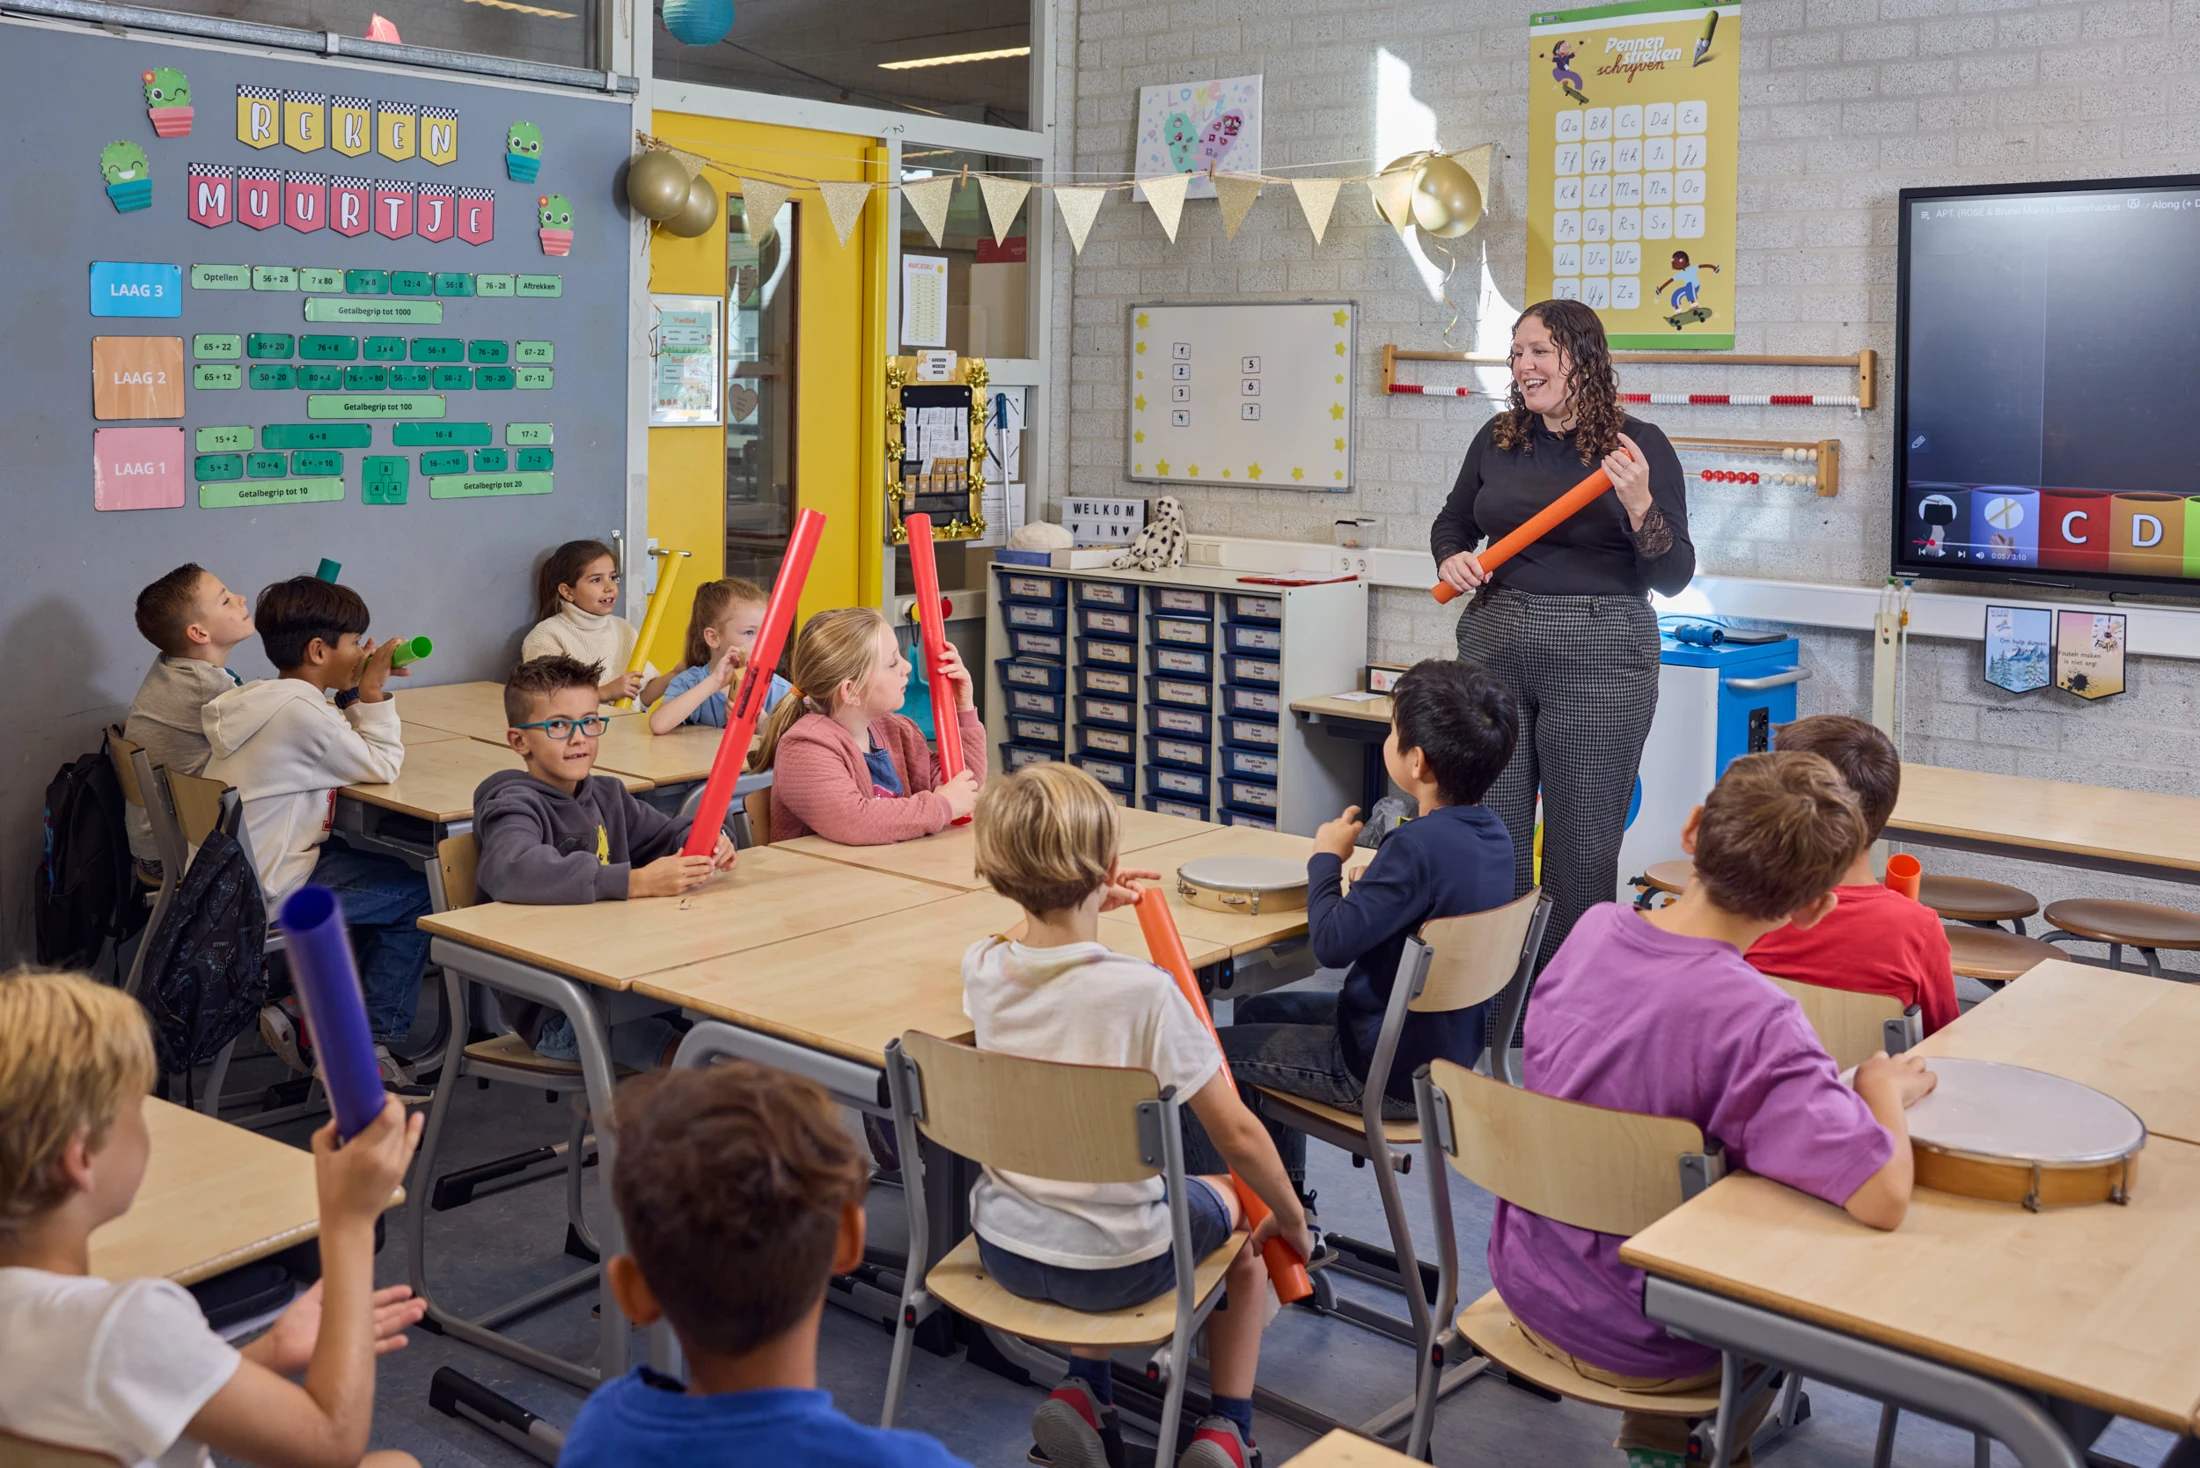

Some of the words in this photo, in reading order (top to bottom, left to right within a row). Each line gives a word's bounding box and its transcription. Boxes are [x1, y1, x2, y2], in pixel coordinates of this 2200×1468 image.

[1605, 37, 1665, 53] Pennen
[1623, 48, 1682, 64] streken
[251, 102, 452, 157] REKEN
[198, 182, 480, 234] MUURTJE
[2152, 200, 2180, 211] Along
[204, 273, 238, 281] Optellen
[111, 284, 150, 298] LAAG
[155, 285, 163, 298] 3
[523, 282, 555, 290] Aftrekken
[338, 307, 381, 316] Getalbegrip
[395, 308, 411, 316] 1000
[1179, 347, 1184, 355] 1
[1249, 360, 1254, 369] 5
[1179, 368, 1184, 376] 2
[114, 372, 153, 385] LAAG
[157, 372, 166, 384] 2
[1179, 389, 1184, 397] 3
[344, 403, 386, 412] Getalbegrip
[1178, 414, 1184, 422] 4
[115, 463, 154, 476] LAAG
[159, 462, 166, 474] 1
[464, 482, 502, 490] Getalbegrip
[238, 489, 285, 499] Getalbegrip
[1073, 503, 1134, 517] WELKOM
[2061, 510, 2089, 544] C
[2131, 513, 2163, 547] D
[1991, 552, 2006, 560] 0:05
[2011, 553, 2026, 562] 3:10
